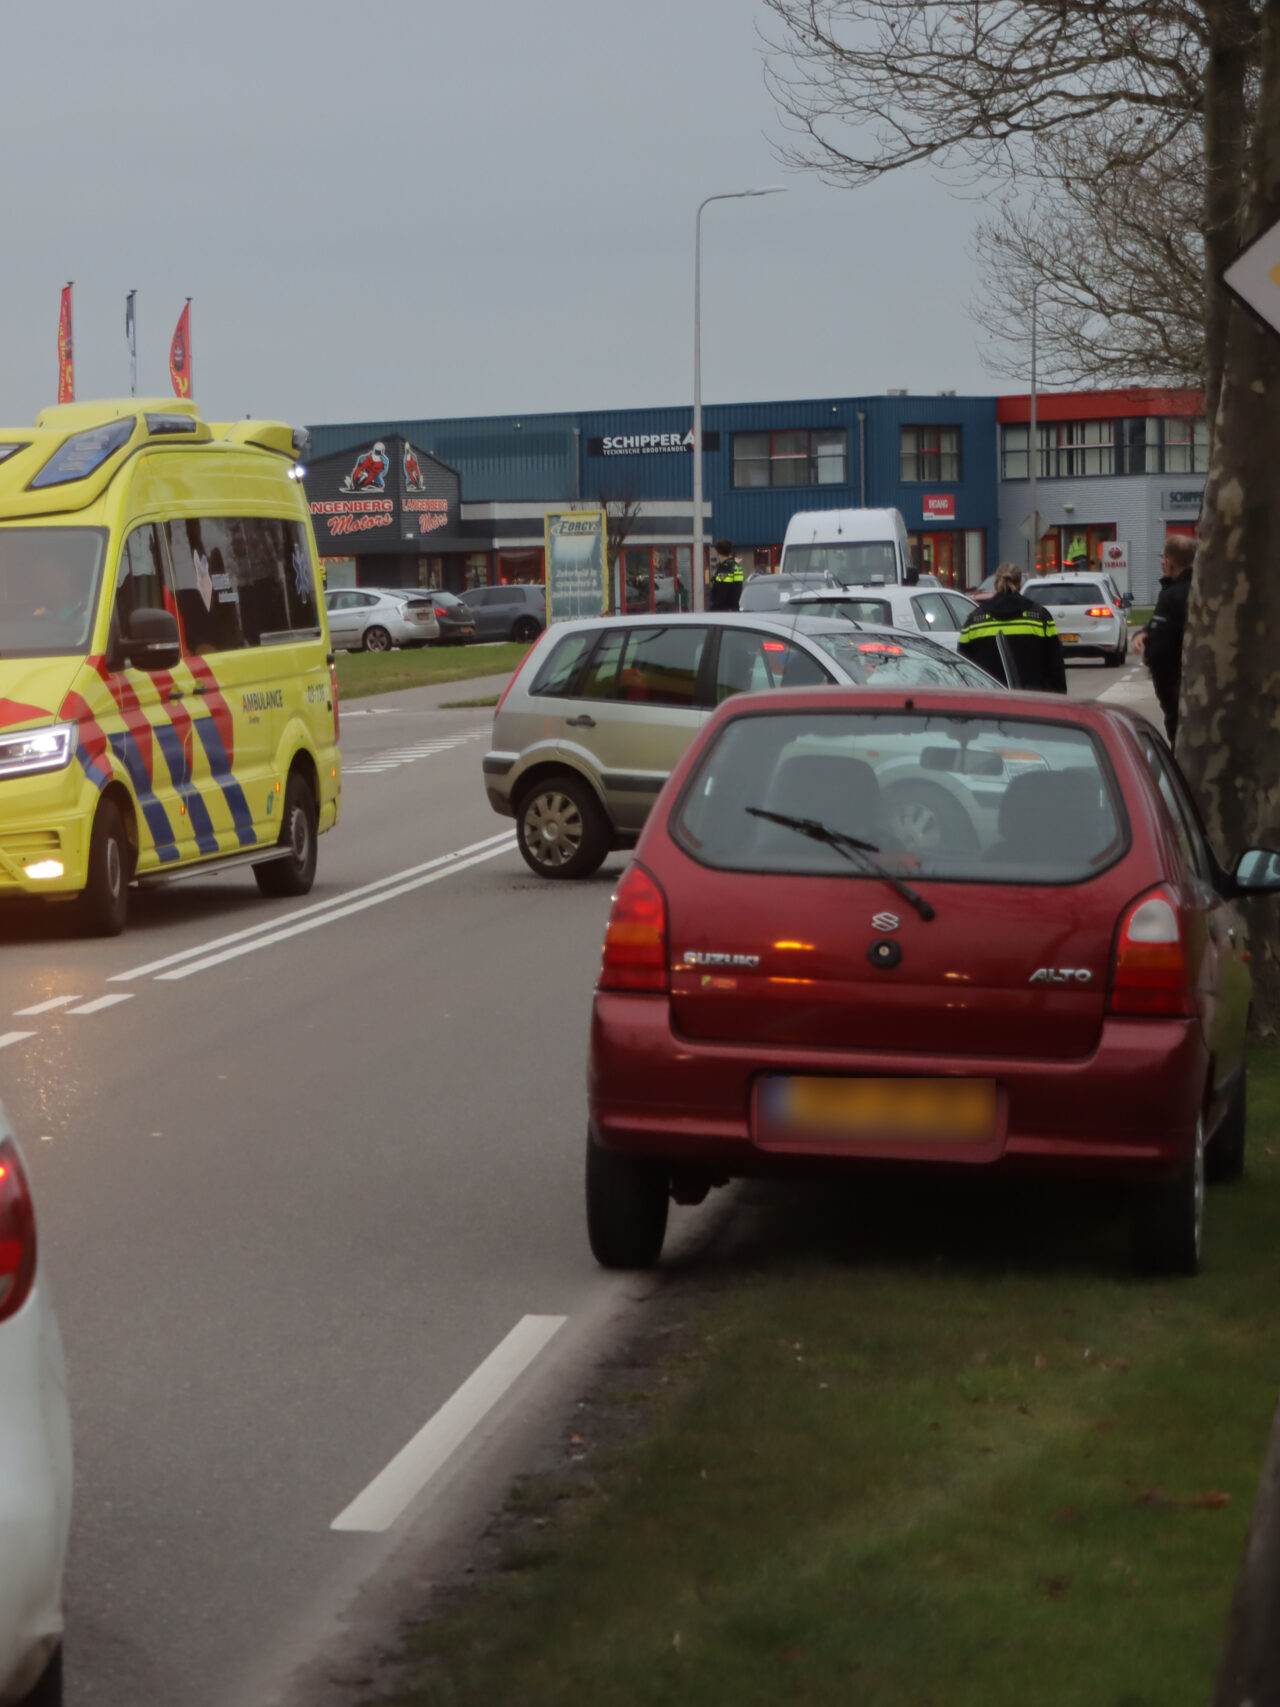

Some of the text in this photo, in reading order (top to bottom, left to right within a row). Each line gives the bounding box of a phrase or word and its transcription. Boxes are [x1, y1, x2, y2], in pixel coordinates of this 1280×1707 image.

[603, 446, 688, 456] TECHNISCHE GROOTHANDEL
[307, 499, 393, 513] NGENBERG
[402, 498, 448, 512] LANGENBERG
[328, 512, 393, 536] Motors
[418, 512, 448, 533] Motors
[559, 520, 600, 533] FORCYS
[243, 689, 283, 712] AMBULANCE
[683, 951, 760, 968] SUZUKI
[1028, 968, 1092, 982] ALTO
